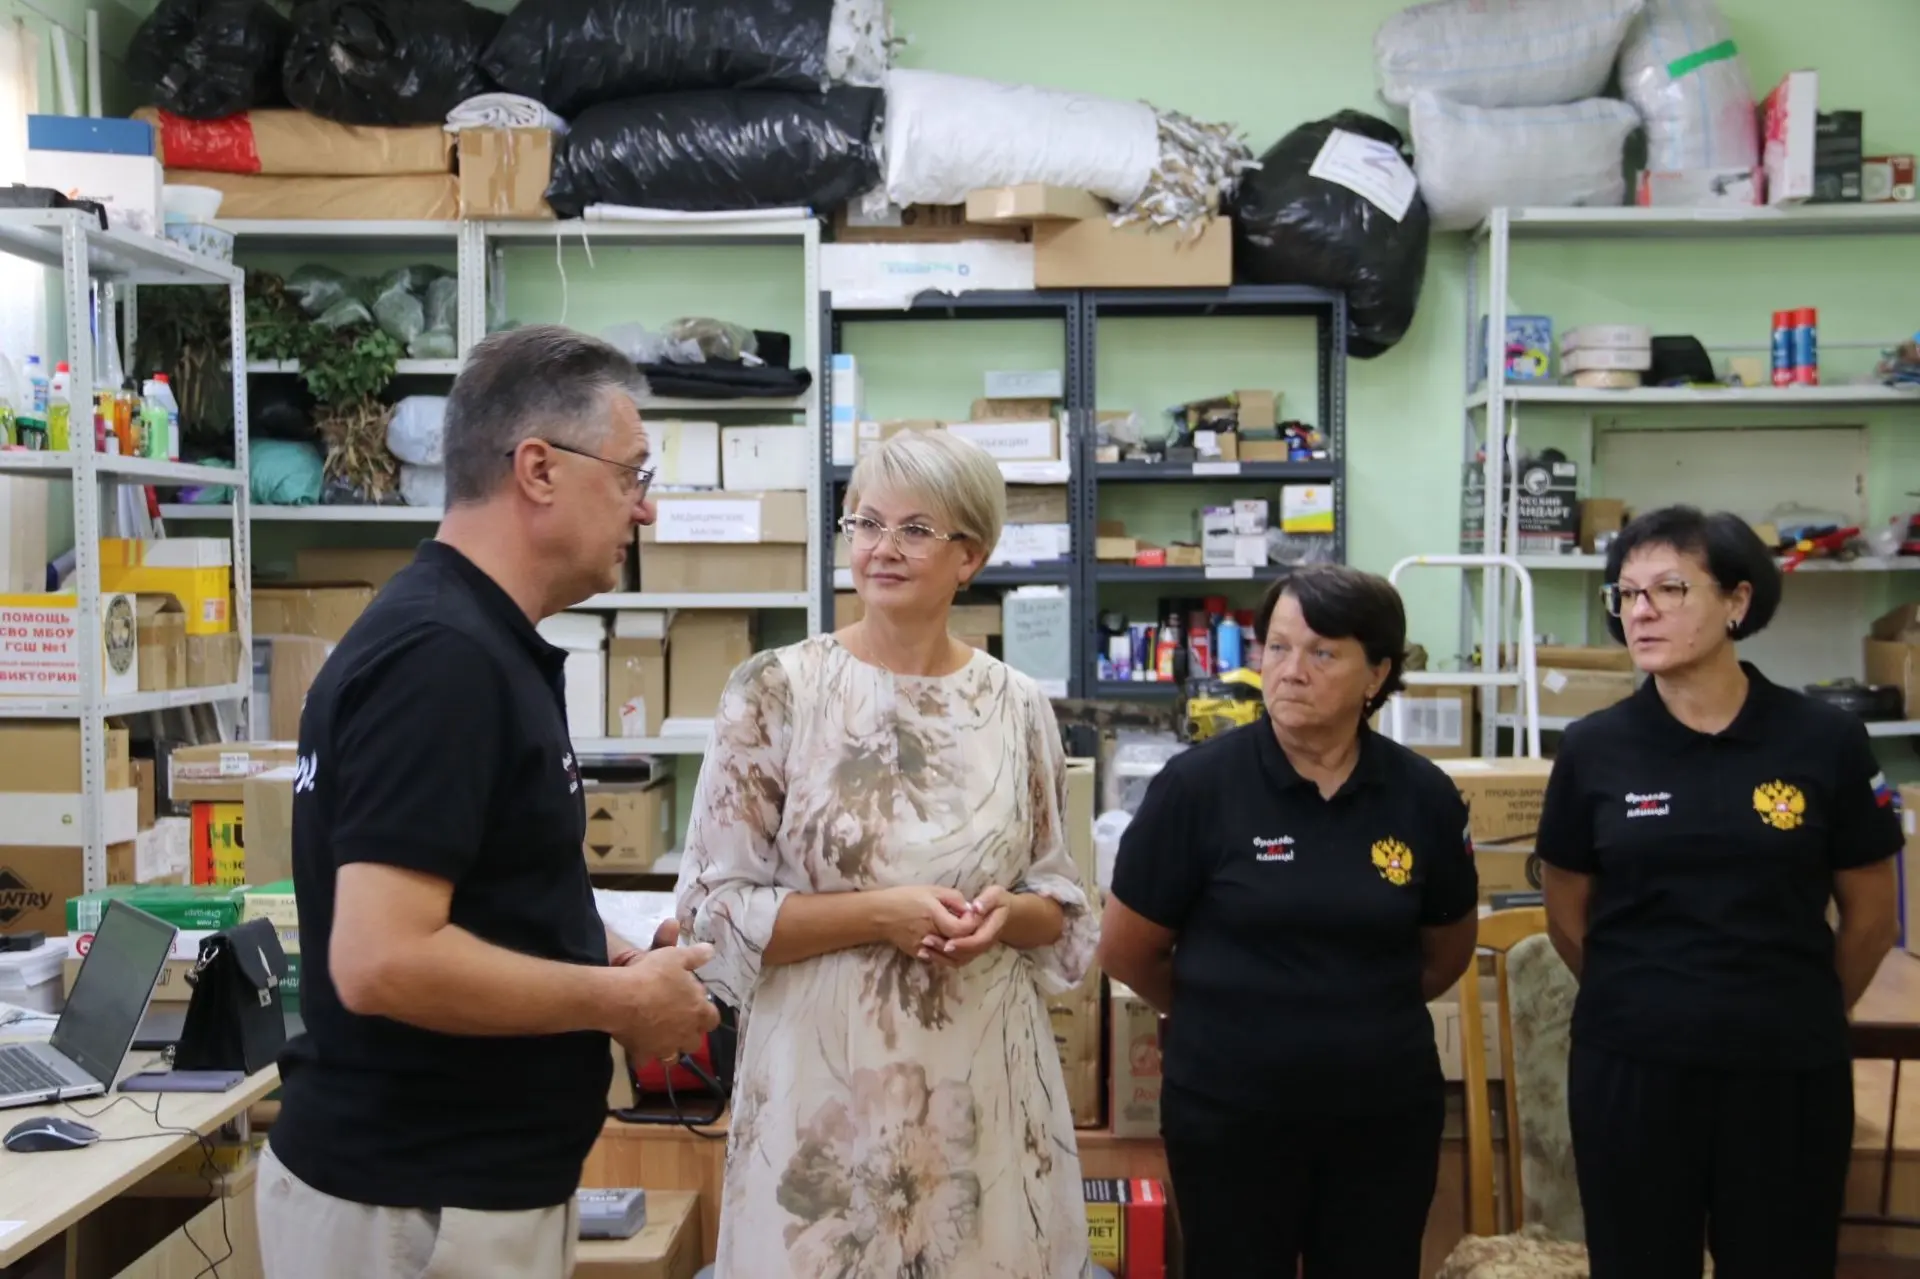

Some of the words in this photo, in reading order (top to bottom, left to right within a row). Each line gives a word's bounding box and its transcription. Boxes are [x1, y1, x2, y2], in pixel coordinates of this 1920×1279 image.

[1518, 496, 1562, 506] УССКИЙ
[2, 612, 70, 624] ПОМОЩЬ
[0, 627, 28, 638] СВО
[33, 628, 75, 638] МБОУ
[5, 641, 37, 653] ГСШ
[0, 891, 53, 910] NTRY
